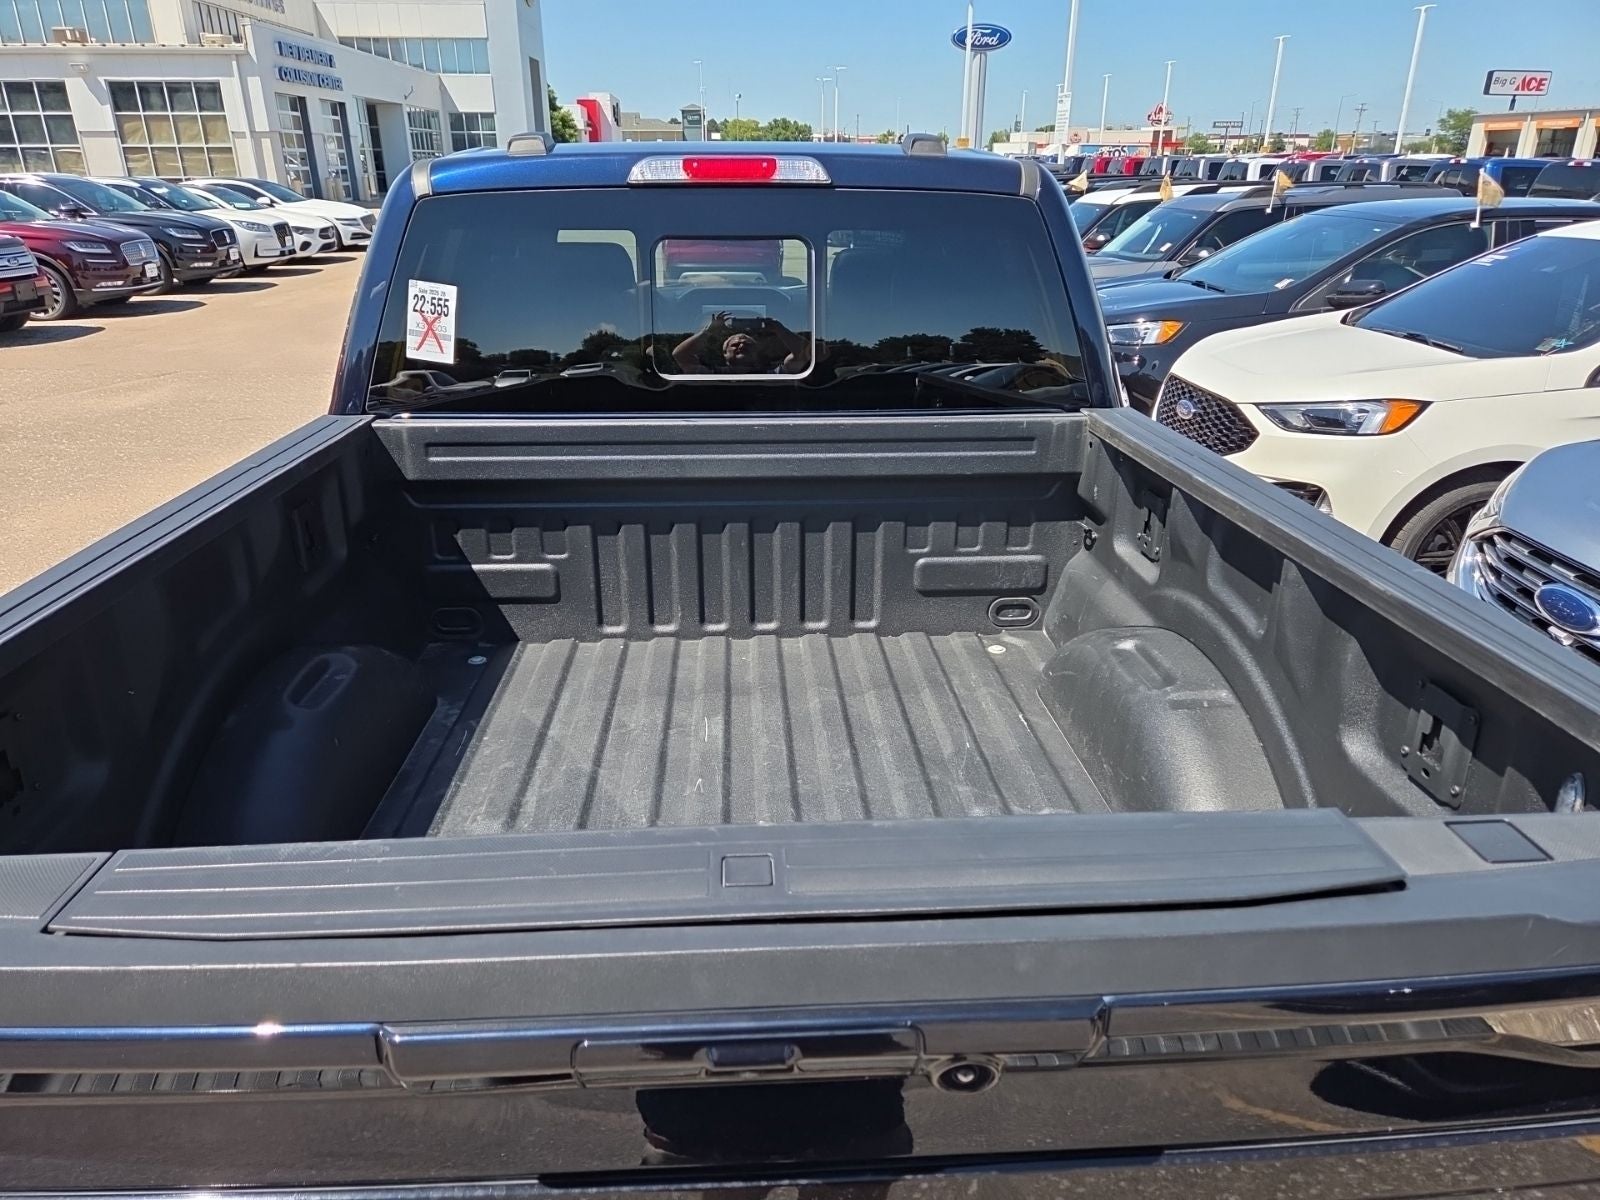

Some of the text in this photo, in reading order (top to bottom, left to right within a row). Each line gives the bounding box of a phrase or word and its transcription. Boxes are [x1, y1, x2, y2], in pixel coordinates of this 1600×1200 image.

[964, 29, 1000, 46] Ford
[281, 42, 300, 60] NEW
[300, 46, 330, 67] DELIVERY
[281, 67, 343, 91] COLLISION CENTER
[1493, 75, 1548, 92] Big G ACE
[412, 294, 449, 317] 22:555
